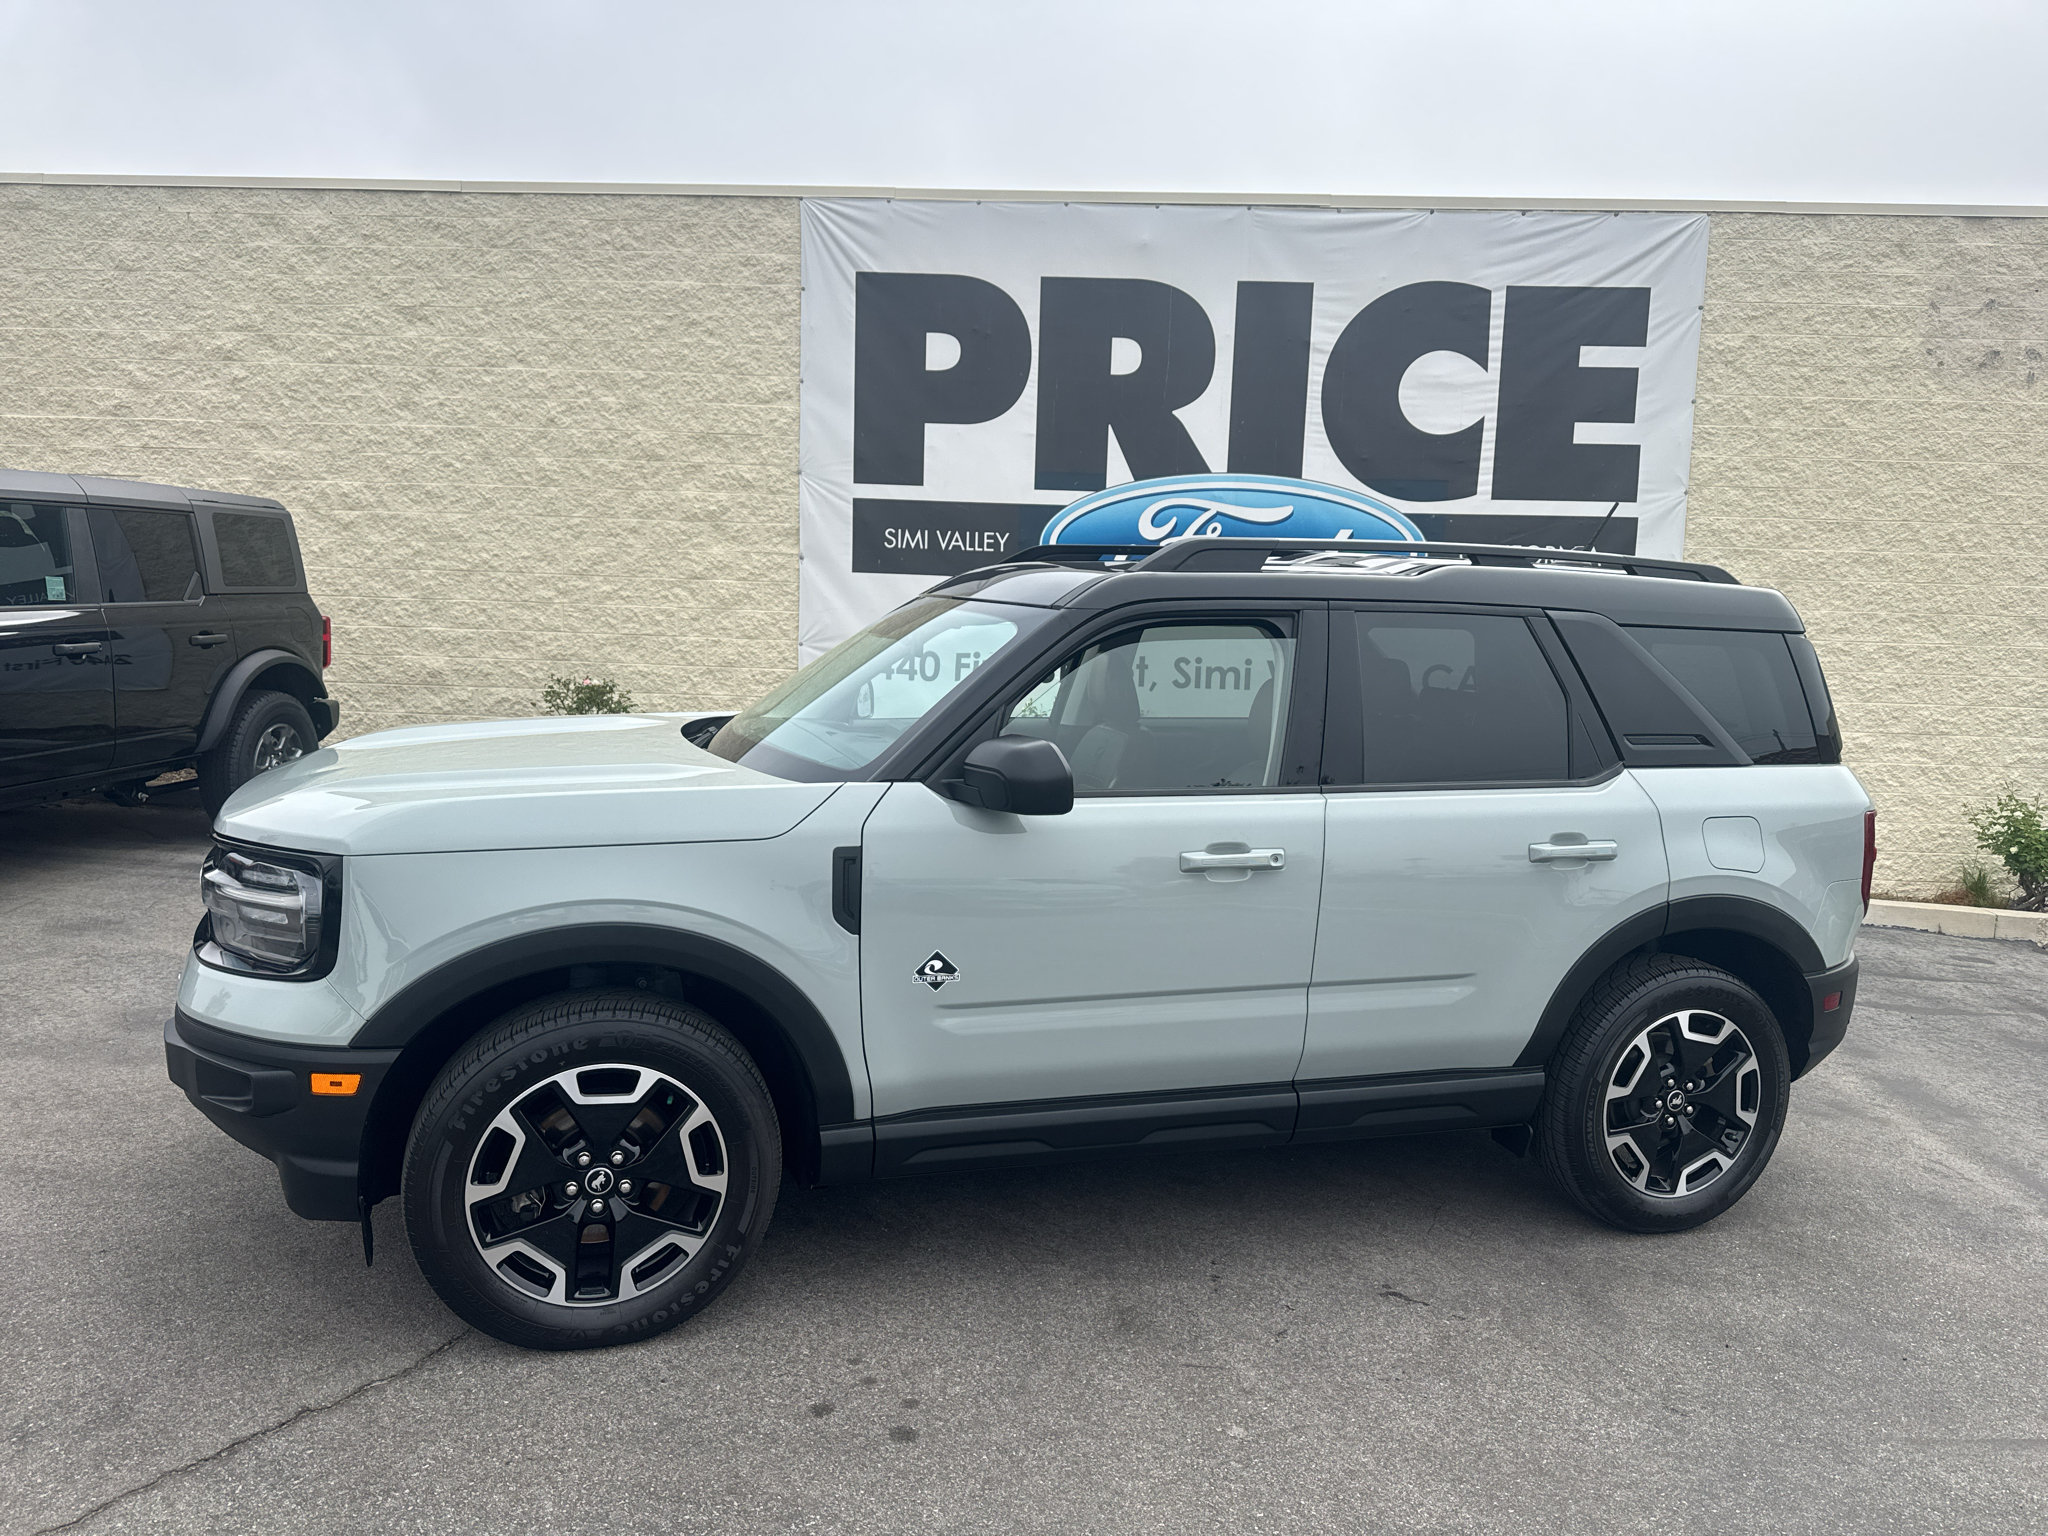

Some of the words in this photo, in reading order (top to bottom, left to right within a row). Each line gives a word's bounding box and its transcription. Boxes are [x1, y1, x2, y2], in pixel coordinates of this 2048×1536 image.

[853, 271, 1652, 503] PRICE
[883, 528, 929, 550] SIMI
[936, 530, 1011, 553] VALLEY
[1171, 656, 1253, 691] Simi
[448, 1035, 590, 1131] Firestone
[612, 1243, 743, 1338] Firestone
